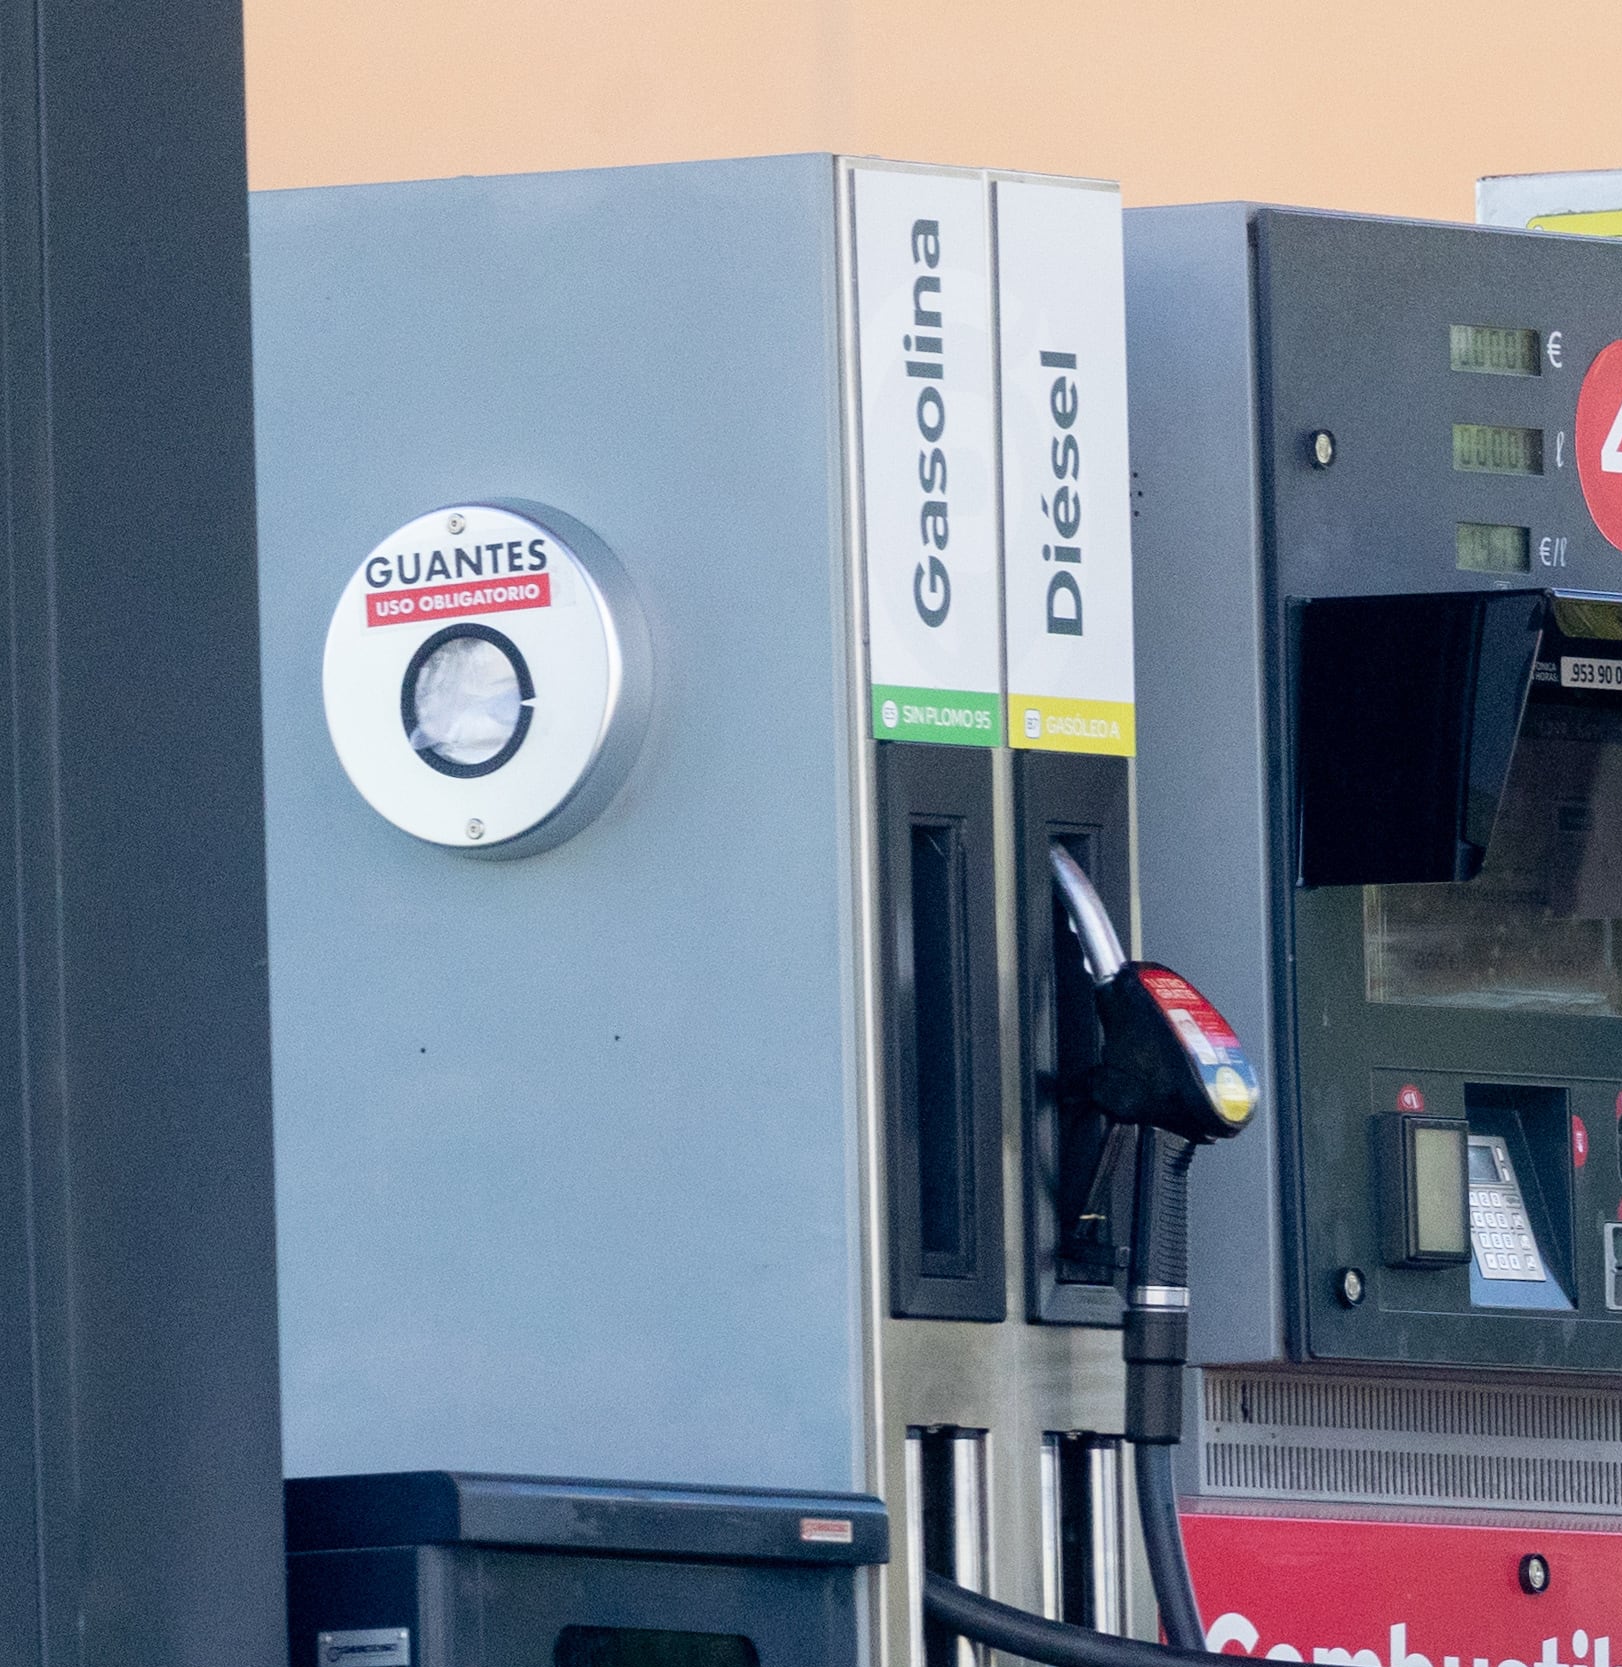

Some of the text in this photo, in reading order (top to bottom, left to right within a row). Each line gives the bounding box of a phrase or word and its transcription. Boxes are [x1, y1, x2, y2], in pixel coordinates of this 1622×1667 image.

[1546, 330, 1563, 369] €
[903, 218, 952, 629] Gasolina
[1039, 349, 1084, 637] Diésel
[365, 538, 549, 589] GUANTES
[375, 583, 541, 618] USO OBLIGATORIO
[1597, 664, 1613, 685] 90
[902, 704, 992, 731] SIN PLOMO 95
[1045, 712, 1122, 740] GASÓLEO A
